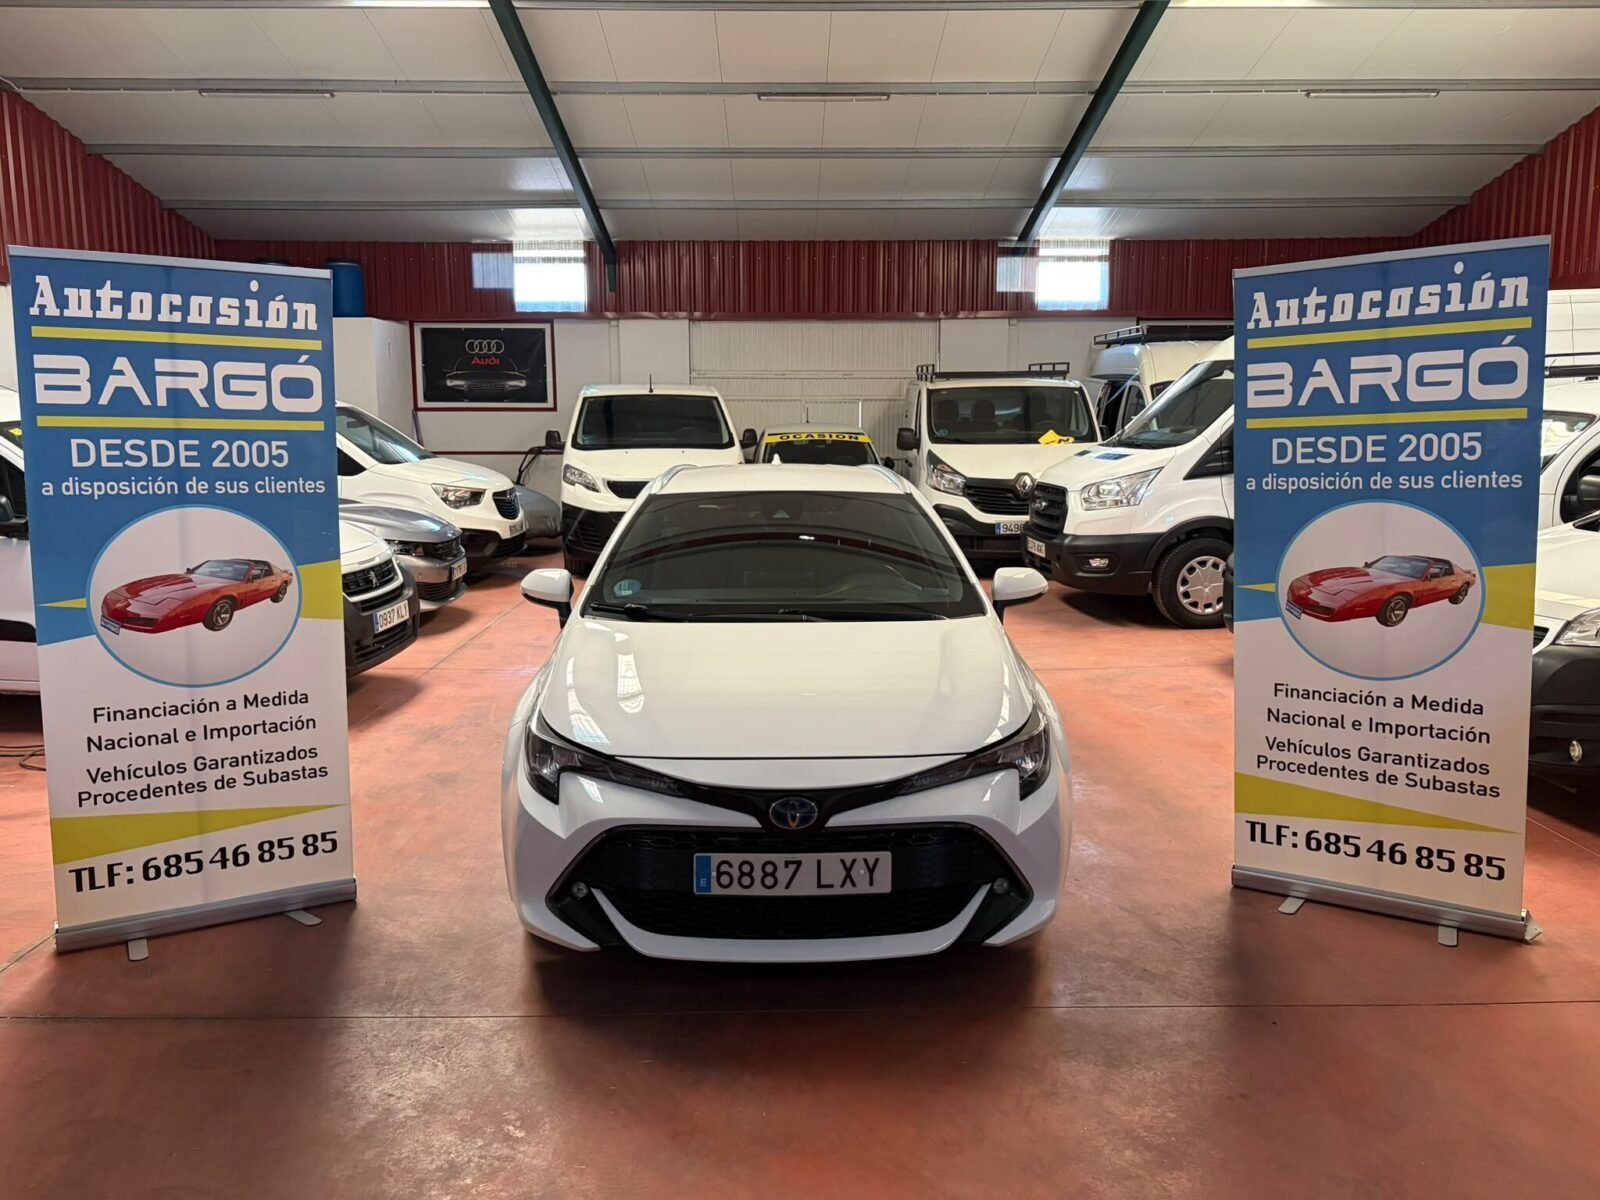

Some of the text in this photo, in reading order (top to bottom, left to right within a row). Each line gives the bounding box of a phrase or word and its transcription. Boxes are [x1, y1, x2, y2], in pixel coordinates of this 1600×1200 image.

[471, 356, 500, 365] Audi
[1247, 335, 1529, 409] BARGÓ
[33, 354, 323, 413] BARGÓ
[70, 438, 288, 468] DESDE 2005
[1271, 432, 1482, 465] DESDE 2005
[42, 476, 326, 500] a disposición de sus clientes
[1246, 470, 1523, 494] a disposición de sus clientes
[93, 690, 310, 724] Financiación a Medida
[1274, 682, 1484, 716] Financiación a Medida
[86, 714, 317, 753] Nacional e Importación
[1267, 708, 1491, 745] Nacional e Importación
[86, 746, 319, 785] Vehículos Garantizados
[1265, 736, 1490, 776] Vehículos Garantizados
[78, 764, 329, 808] Procedentes de Subastas
[1256, 755, 1501, 799] Procedentes de Subastas
[68, 830, 339, 893] TLF: 685 46 85 85
[1246, 820, 1506, 882] TLF: 685 46 85 85
[716, 857, 880, 890] 6887 LXY
